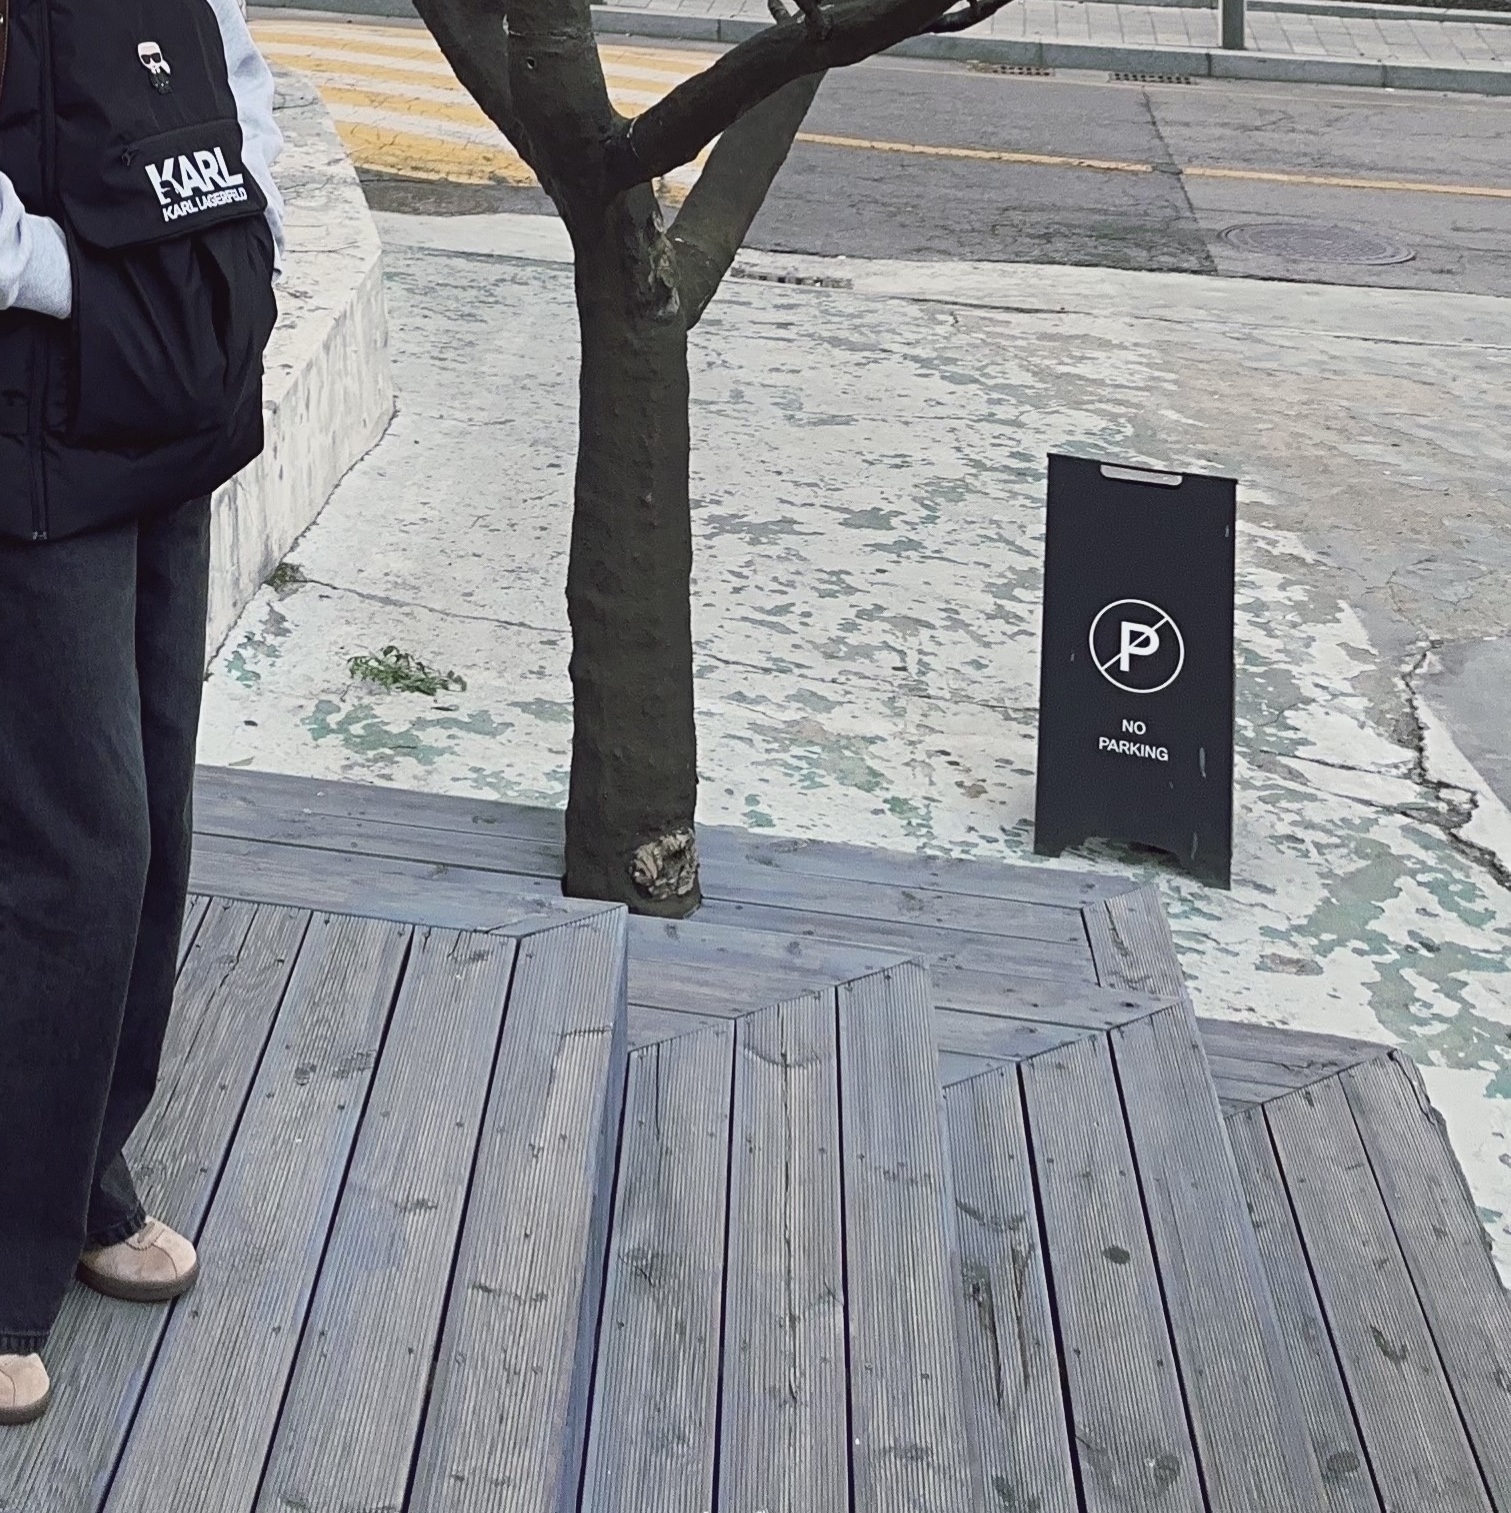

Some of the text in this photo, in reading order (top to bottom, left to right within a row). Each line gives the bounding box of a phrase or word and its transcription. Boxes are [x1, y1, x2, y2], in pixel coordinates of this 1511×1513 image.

[144, 146, 244, 206] KARL
[162, 186, 248, 222] KARL LAGERFELD
[1121, 718, 1147, 735] NO
[1098, 736, 1169, 762] PARKING
